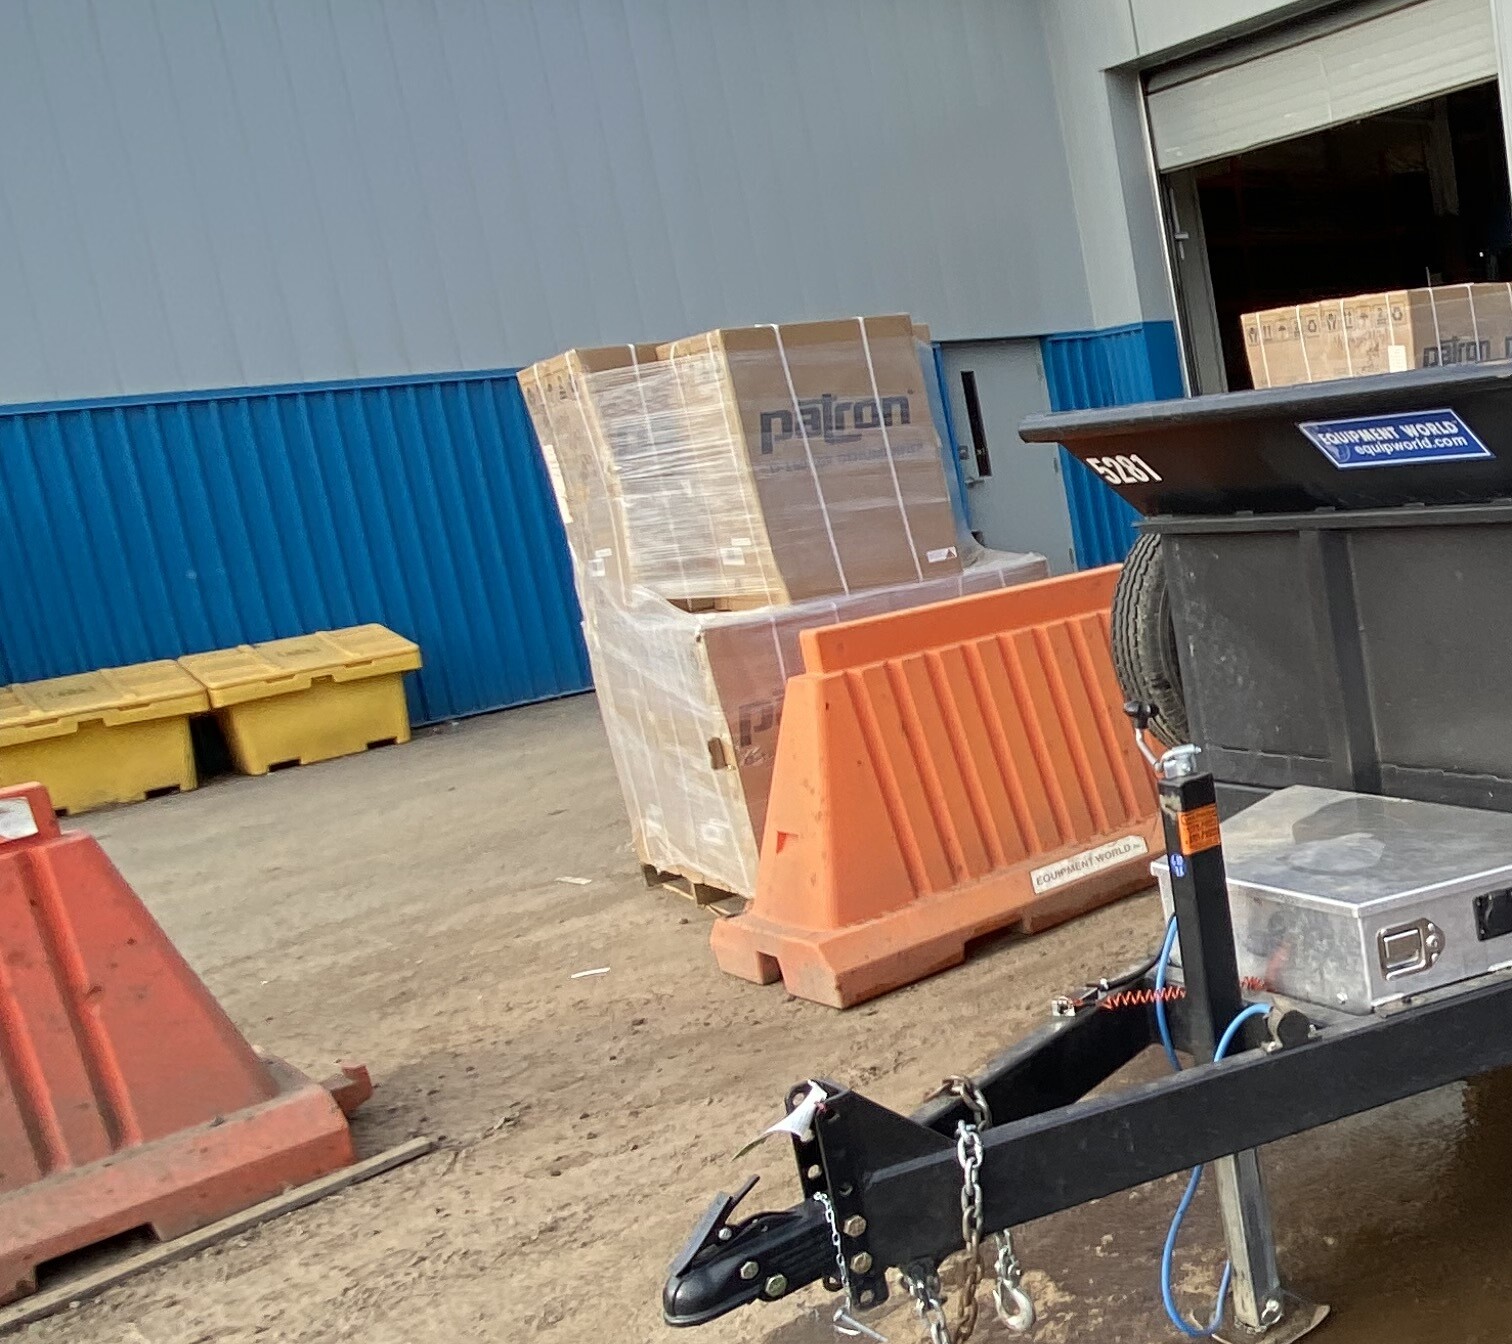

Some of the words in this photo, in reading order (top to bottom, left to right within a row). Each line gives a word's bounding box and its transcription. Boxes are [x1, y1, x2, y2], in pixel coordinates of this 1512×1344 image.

[760, 393, 911, 454] patron
[1318, 425, 1400, 446] EQUIPMENT
[1400, 420, 1459, 438] WORLD
[1354, 436, 1469, 455] equipworld.com
[1086, 453, 1163, 485] 5281
[1036, 855, 1094, 886] EQUIPMENT
[1095, 843, 1131, 863] WORLD
